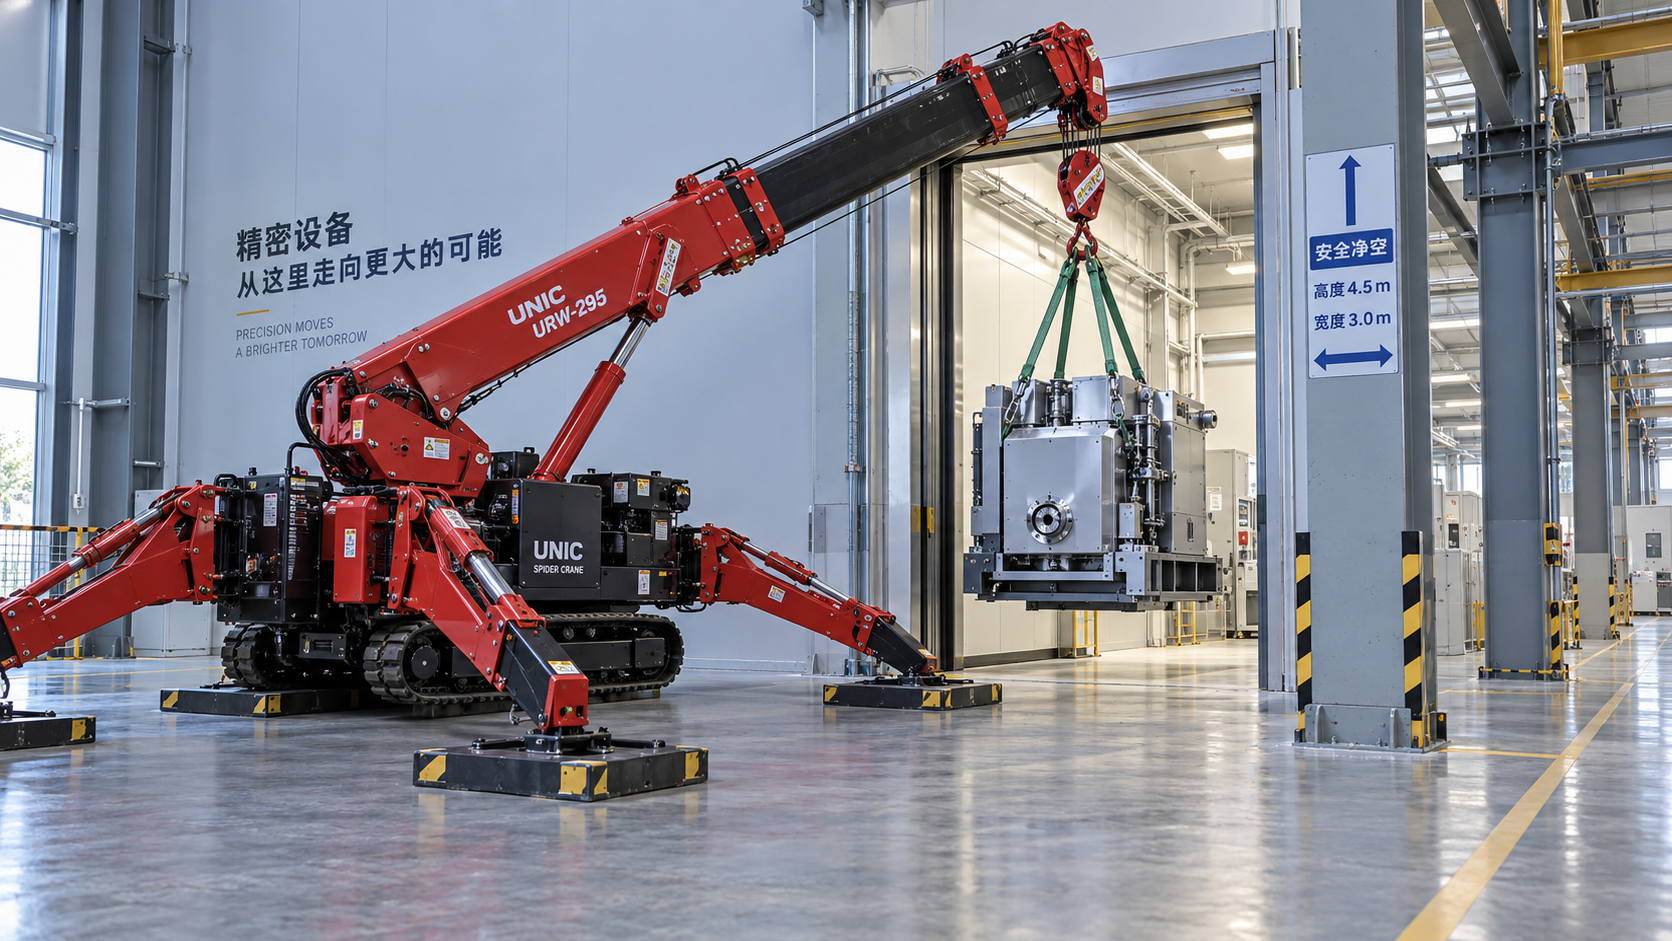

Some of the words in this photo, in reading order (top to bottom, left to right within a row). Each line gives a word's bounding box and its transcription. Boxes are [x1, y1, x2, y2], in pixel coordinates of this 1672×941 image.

[236, 211, 353, 262] 精密设备
[1315, 237, 1387, 262] 安全净空
[237, 227, 502, 298] 从这里走向更大的可能
[507, 285, 566, 325] UNIC
[532, 288, 608, 339] URW-295
[236, 322, 292, 341] PRECISION
[295, 316, 334, 334] MOVES
[235, 347, 243, 358] A
[245, 340, 298, 357] BRIGHTER
[301, 330, 368, 350] TOMORROW
[534, 540, 583, 560] UNIC
[533, 564, 559, 574] SPIDER
